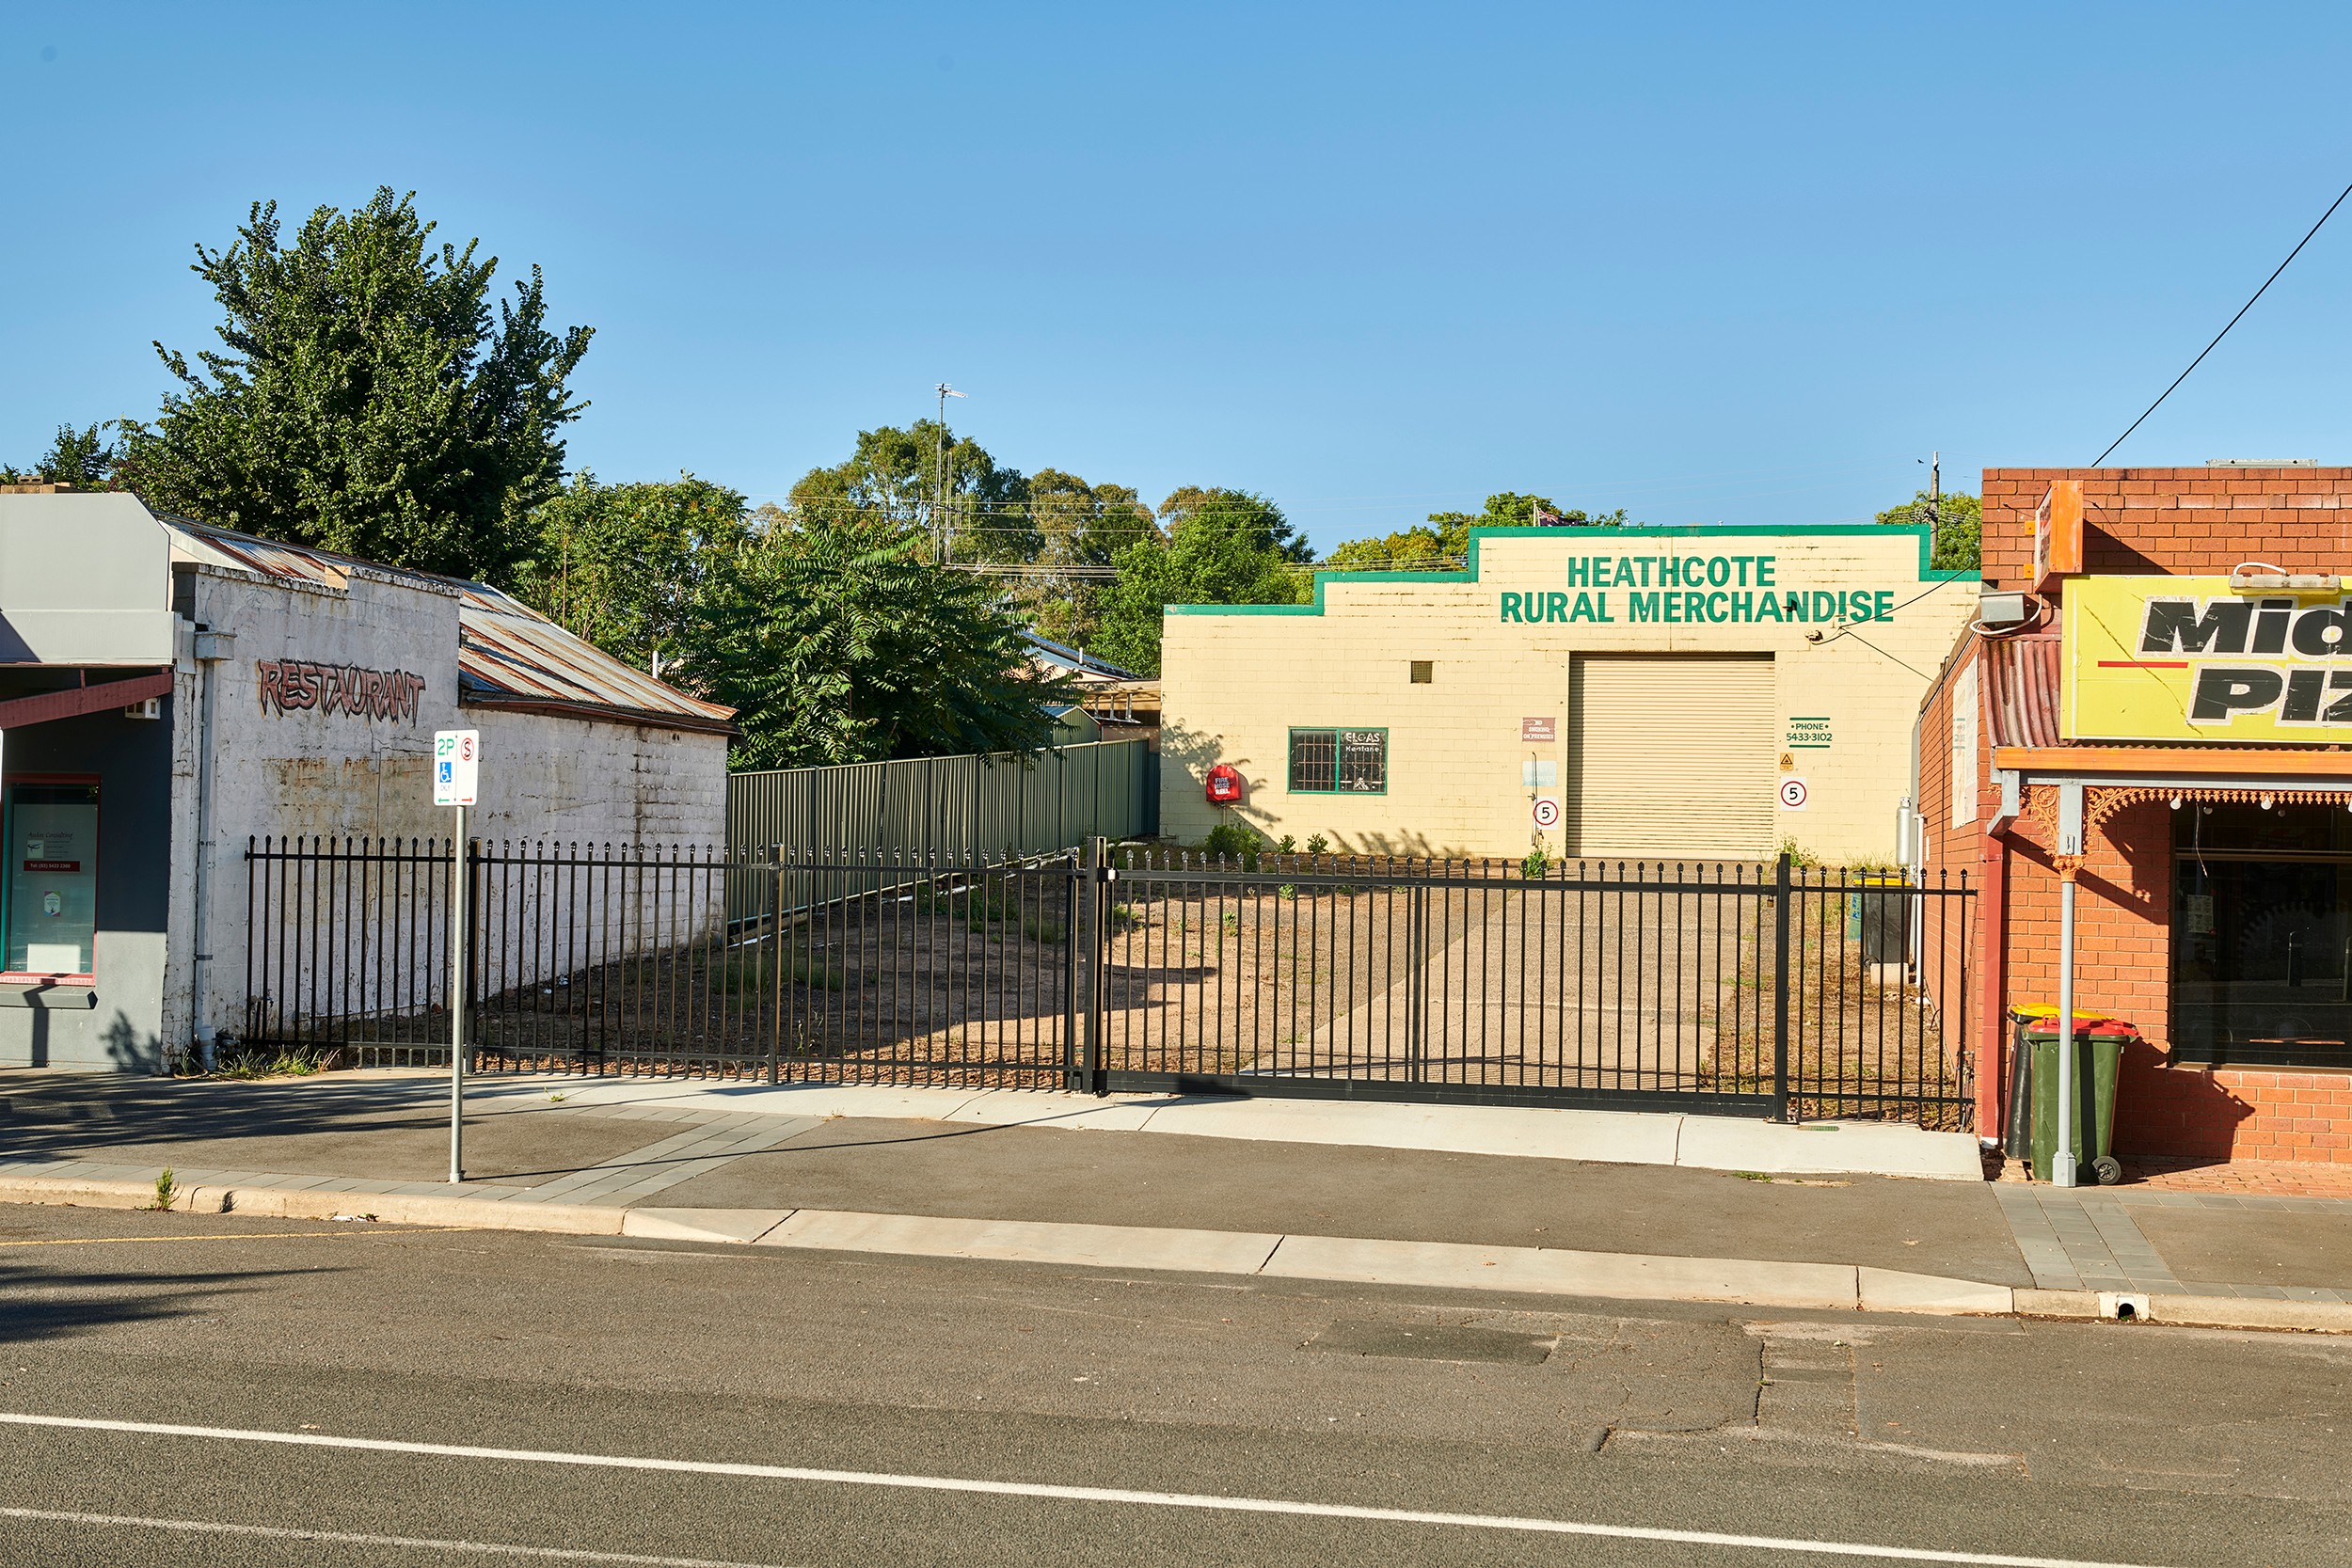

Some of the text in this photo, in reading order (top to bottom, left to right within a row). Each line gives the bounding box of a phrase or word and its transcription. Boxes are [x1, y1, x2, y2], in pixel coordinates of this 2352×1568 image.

[1567, 555, 1776, 588] HEATHCOTE
[1501, 590, 1895, 624] RURAL MERCHANDISE
[257, 657, 426, 729] RESTAURANT
[1345, 732, 1380, 743] ELGAS
[437, 738, 454, 755] 2P
[1789, 787, 1798, 800] 5
[1542, 806, 1550, 819] 5
